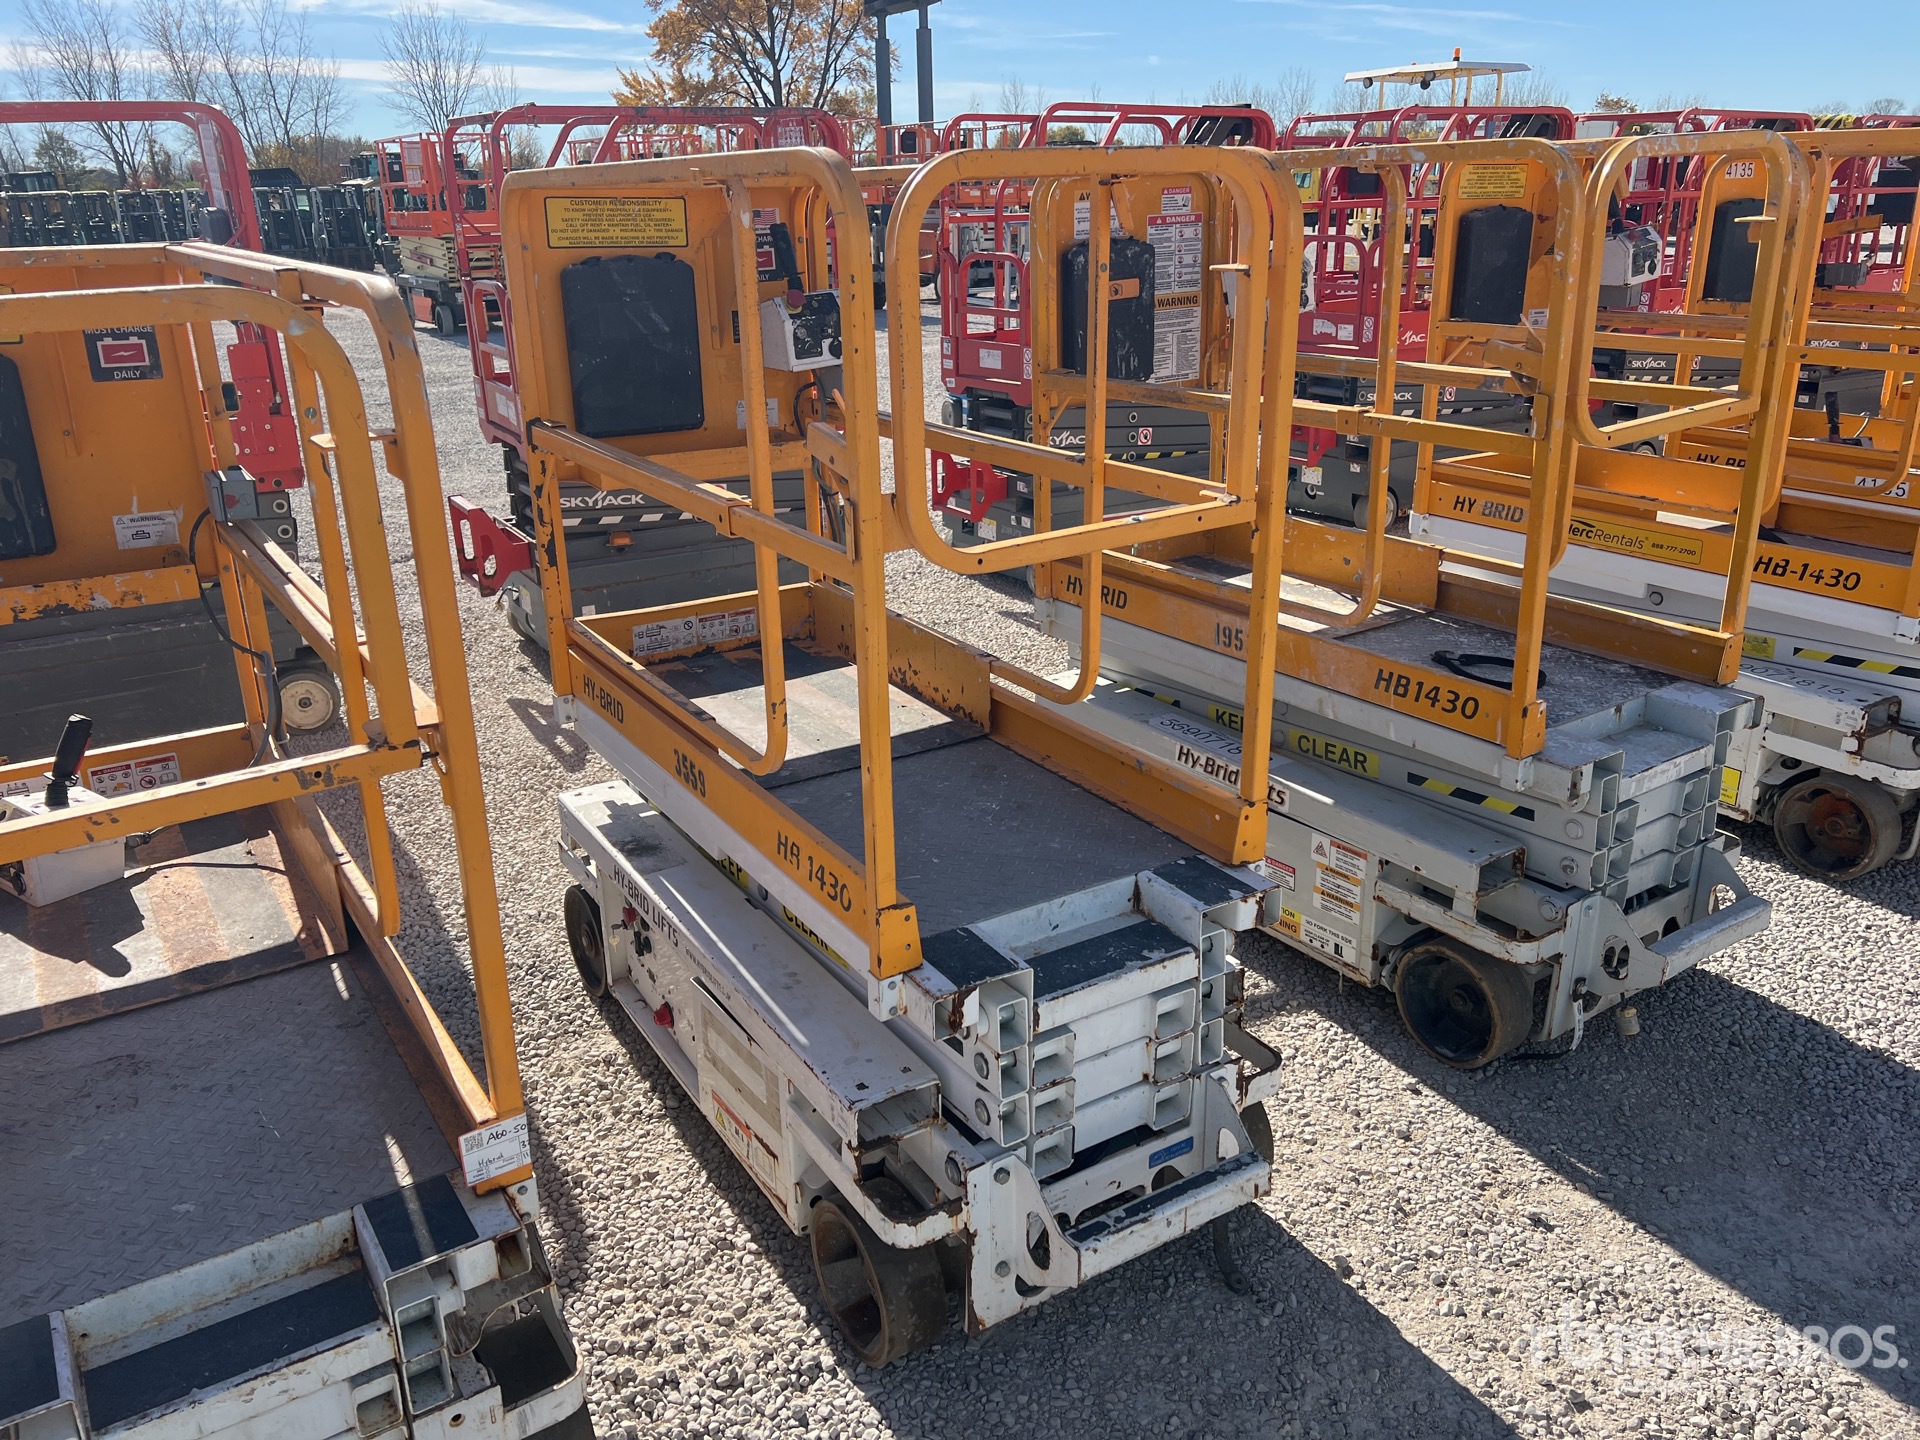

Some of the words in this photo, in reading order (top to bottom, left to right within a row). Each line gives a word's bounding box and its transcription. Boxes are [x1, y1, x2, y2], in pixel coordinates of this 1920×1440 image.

[1726, 162, 1754, 178] 4135
[1166, 215, 1196, 223] DANGER
[1157, 295, 1198, 307] WARNING
[1810, 338, 1840, 347] SKYJACK
[1632, 357, 1666, 369] SKYJACK
[114, 370, 140, 379] DAILY
[1367, 392, 1412, 401] SACK
[560, 490, 645, 508] SKYJACK
[1651, 542, 1697, 556] 888-777-2700
[1753, 556, 1861, 591] HB-1430
[583, 674, 624, 724] HY-BRID
[1374, 668, 1480, 720] HB1430
[1216, 708, 1244, 733] KE
[1298, 734, 1368, 773] CLEAR
[674, 748, 706, 798] 3559
[1177, 745, 1240, 785] Hy-Brid
[808, 855, 852, 912] 1430
[614, 865, 649, 916] HY-BRID
[652, 906, 679, 947] LIFTS
[1325, 892, 1354, 908] WARNING
[1279, 919, 1297, 933] NING
[1314, 923, 1327, 933] FORK
[1328, 930, 1340, 938] THIS
[486, 1124, 526, 1145] A60-50
